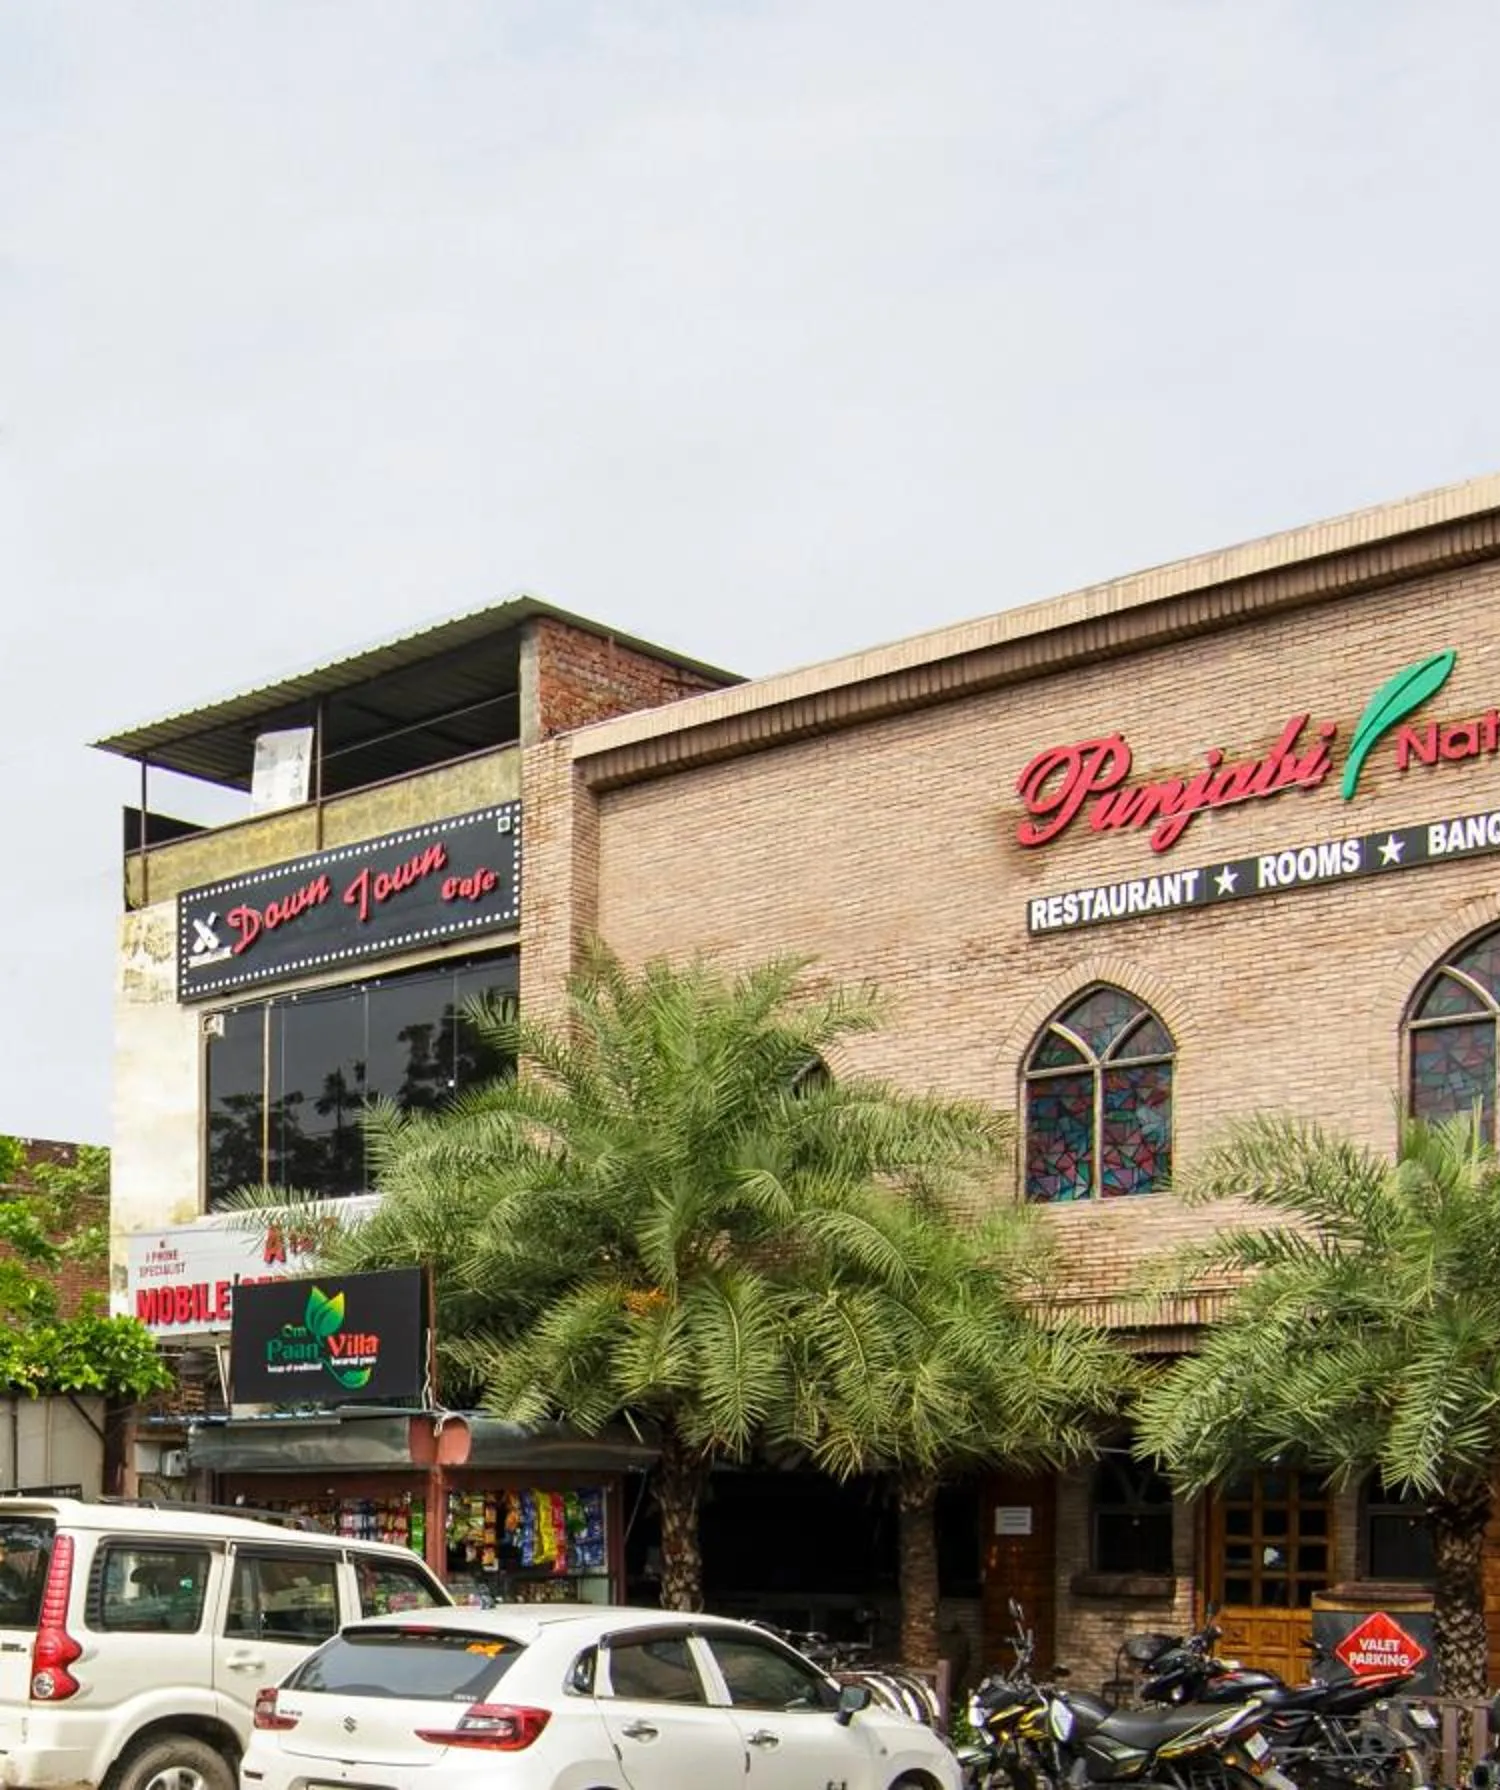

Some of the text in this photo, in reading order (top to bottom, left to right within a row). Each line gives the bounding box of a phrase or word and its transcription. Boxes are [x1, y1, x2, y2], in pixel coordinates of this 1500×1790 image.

[1016, 713, 1338, 852] Punjabi
[227, 841, 447, 955] Down Town
[441, 866, 500, 901] Cafe
[1031, 869, 1200, 931] RESTAURANT
[1257, 839, 1361, 888] ROOMS
[135, 1281, 230, 1326] MOBILE
[266, 1339, 319, 1362] Paan
[327, 1332, 380, 1357] Villa
[1349, 1651, 1410, 1668] PARKING
[1359, 1638, 1401, 1652] VALET
